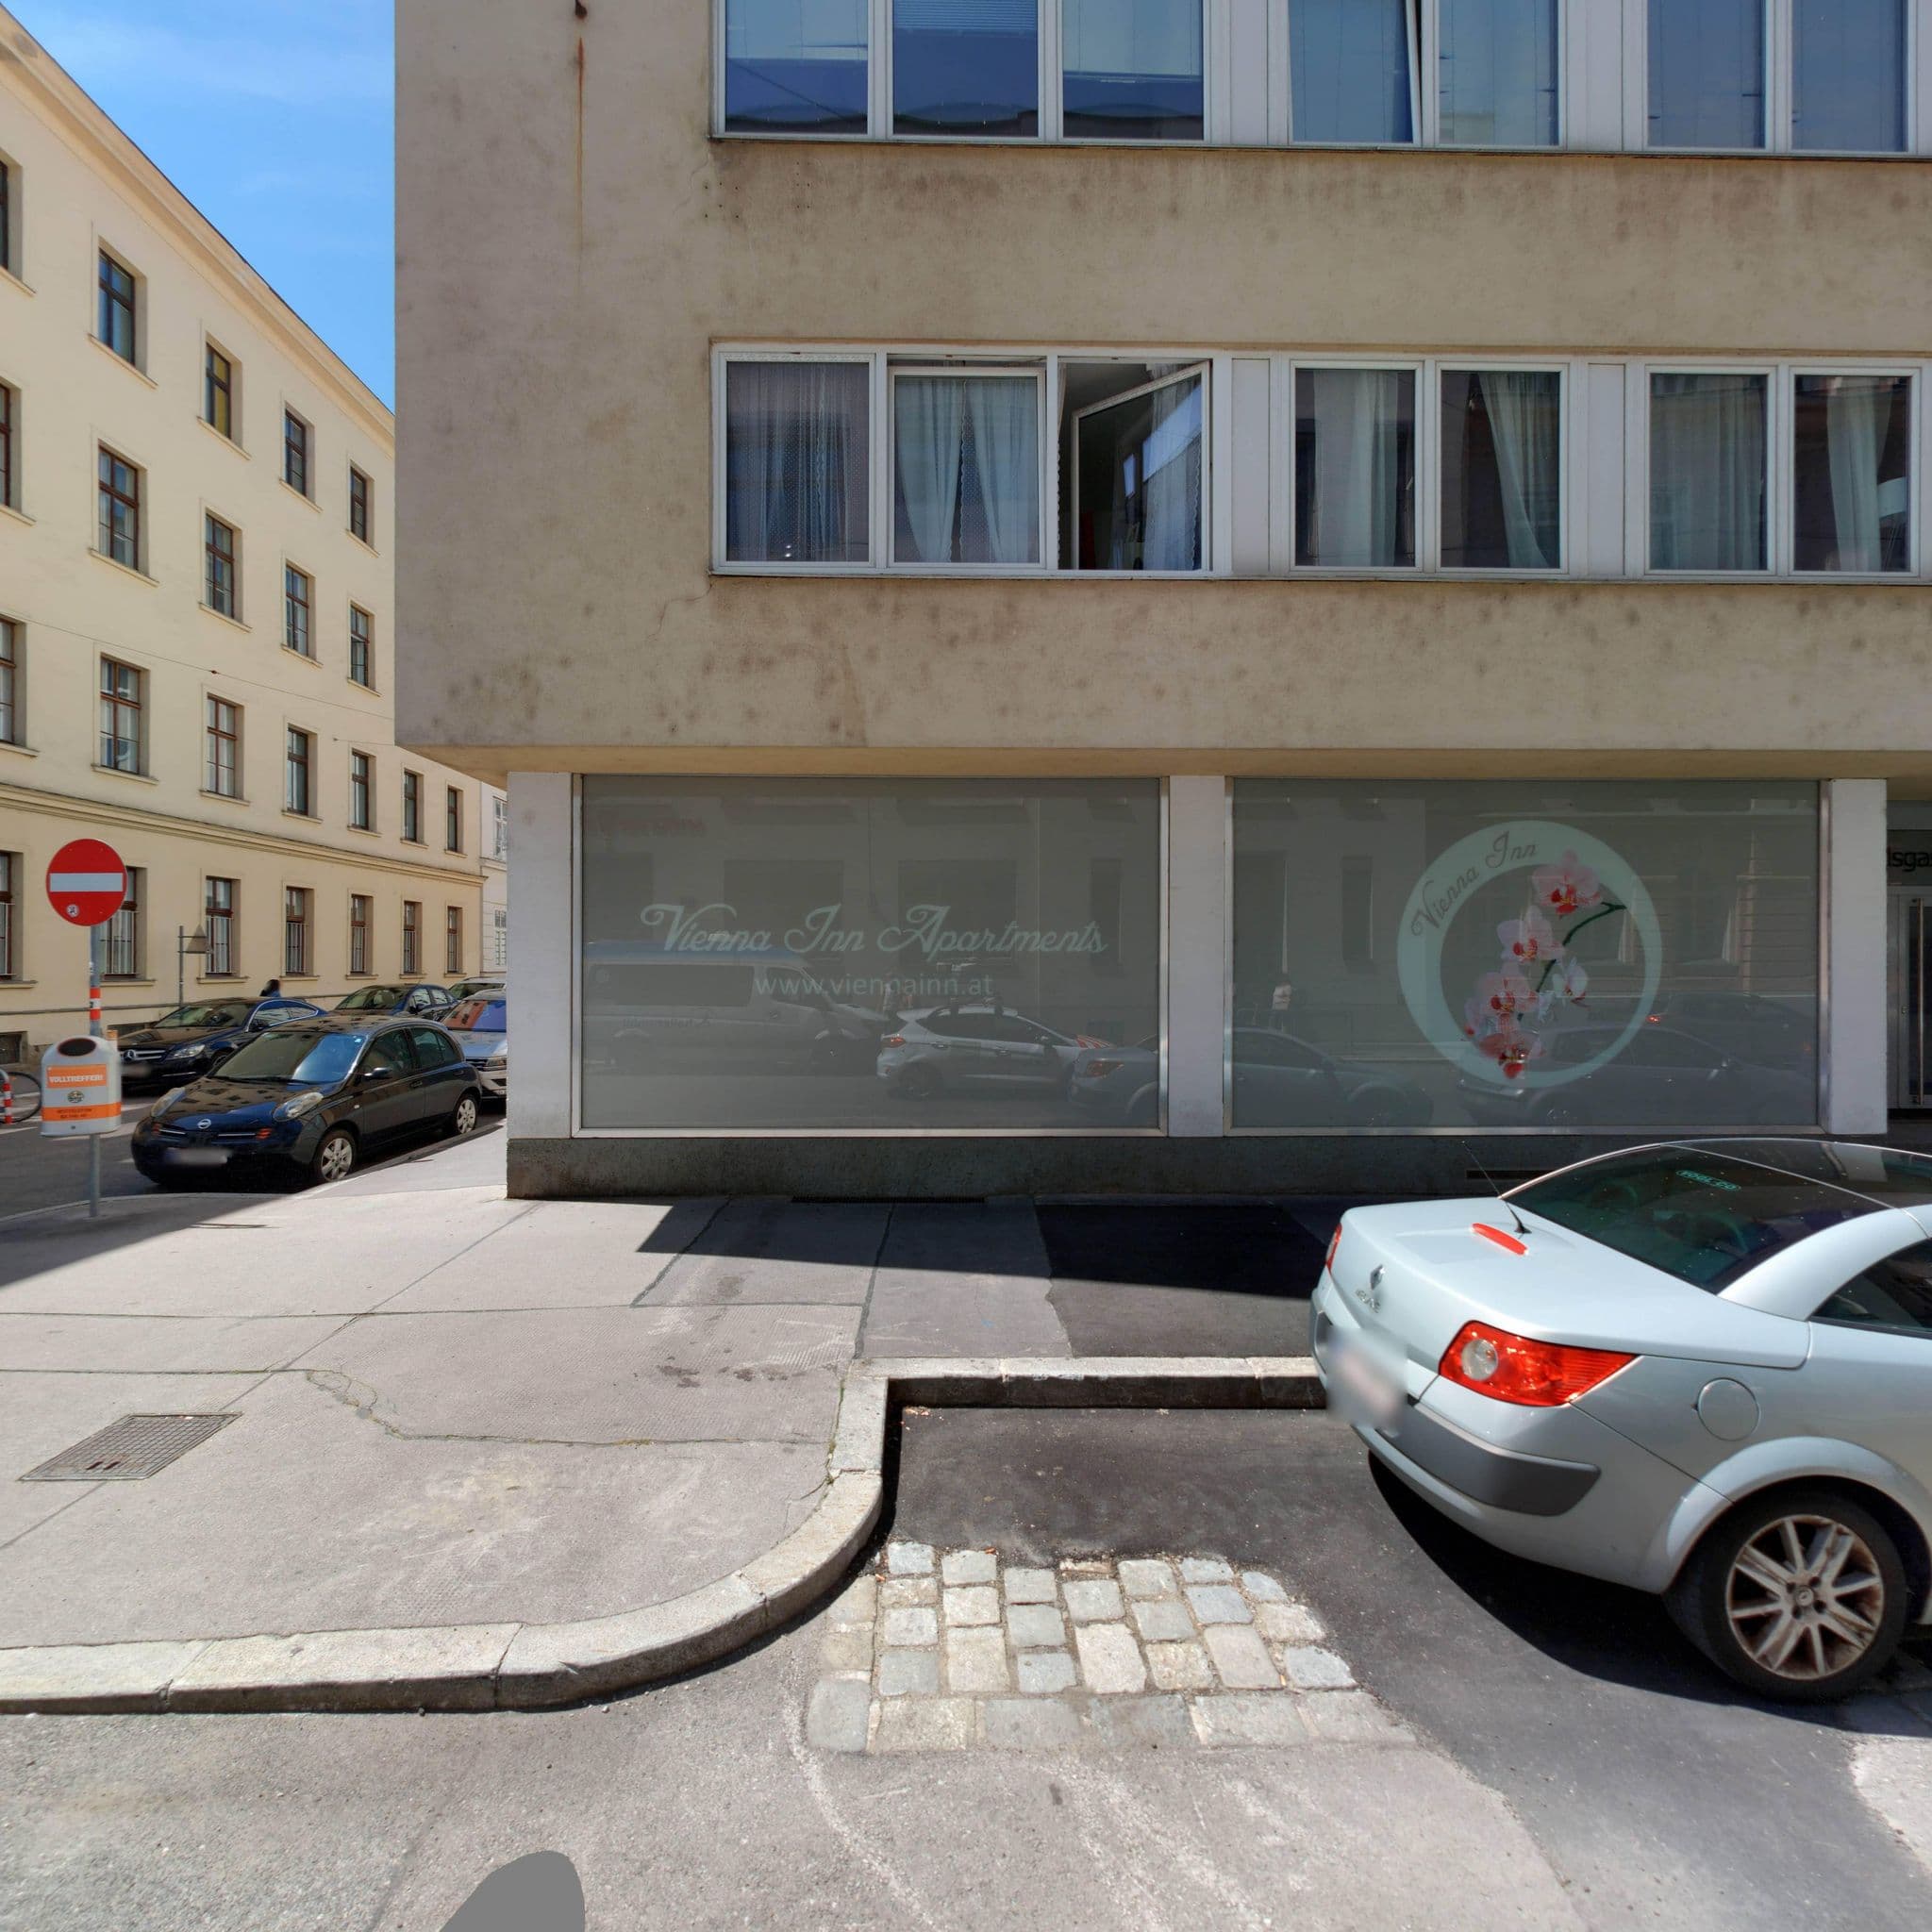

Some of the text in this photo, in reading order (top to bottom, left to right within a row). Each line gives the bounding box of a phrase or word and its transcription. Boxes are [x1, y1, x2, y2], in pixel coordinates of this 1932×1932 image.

[1411, 830, 1539, 936] Vienna Inn
[641, 903, 1108, 962] Vienna Inn Apartments
[754, 973, 994, 997] www.viennainn.at
